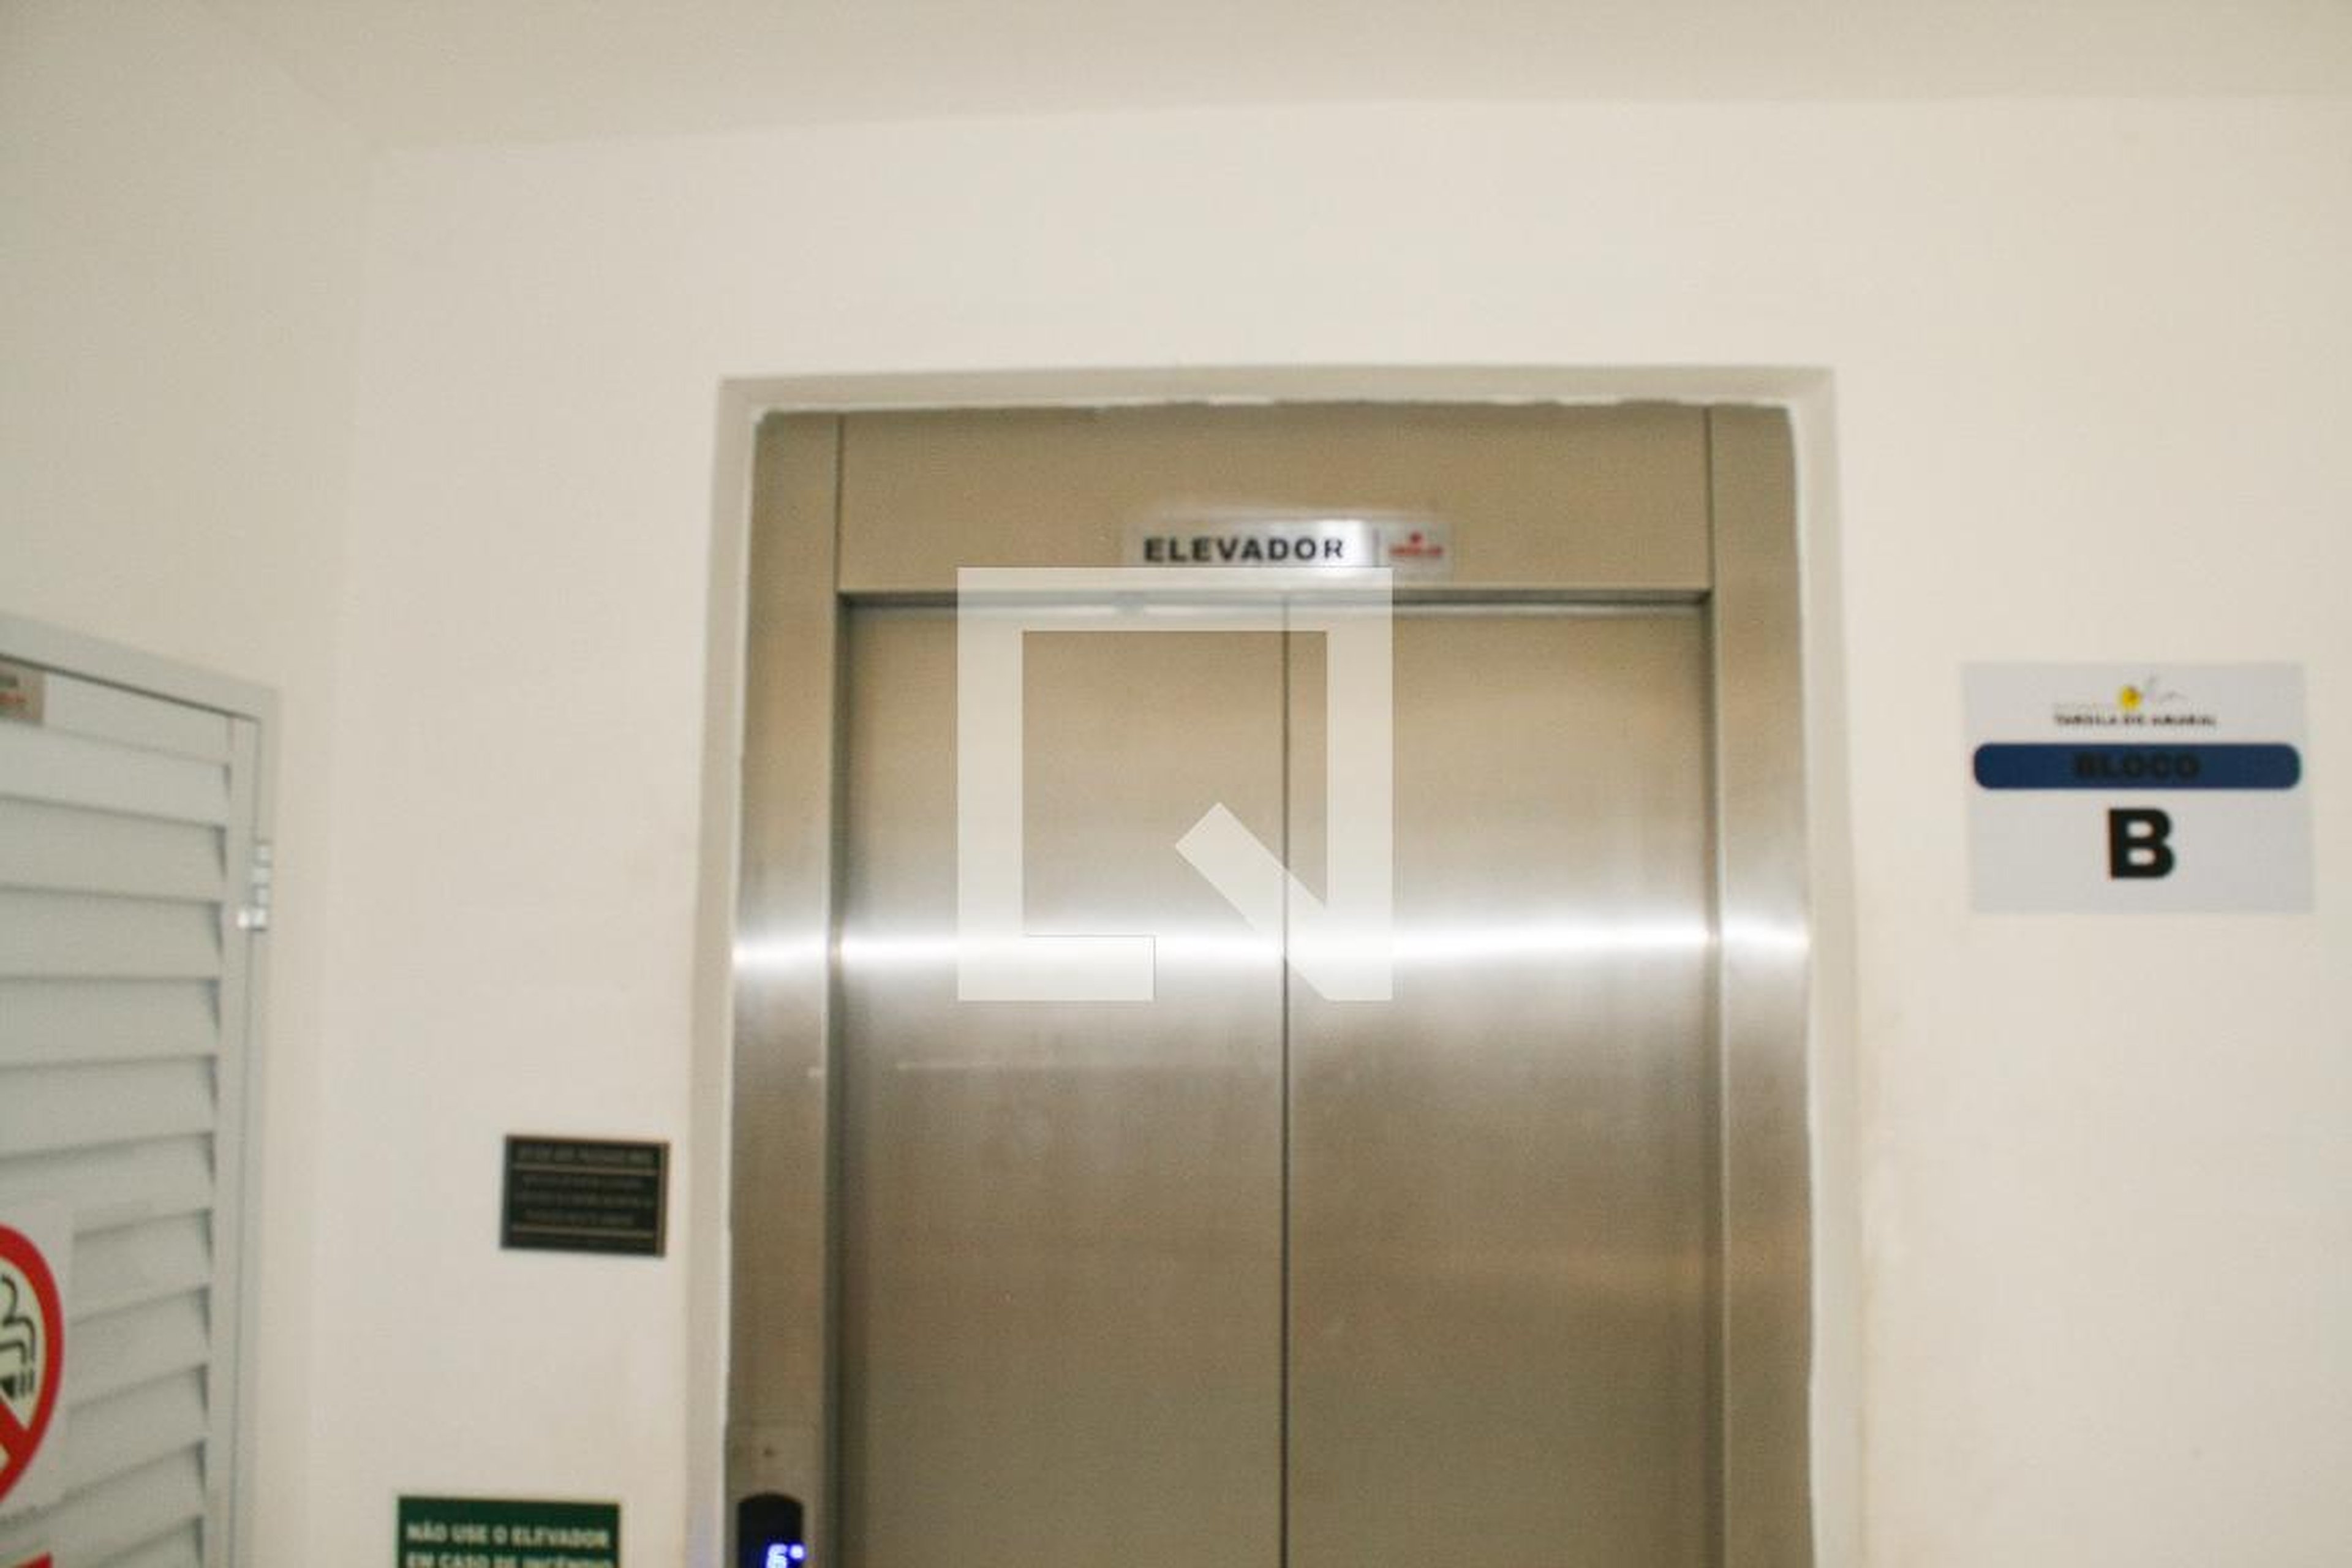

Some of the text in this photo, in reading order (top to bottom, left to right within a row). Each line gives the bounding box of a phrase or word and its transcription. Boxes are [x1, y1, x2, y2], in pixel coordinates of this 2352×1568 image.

[1144, 537, 1344, 563] ELEVADOR
[2073, 752, 2201, 779] BLOCO
[2108, 808, 2175, 879] B
[492, 1524, 508, 1545] O
[511, 1526, 610, 1549] ELEVADOR
